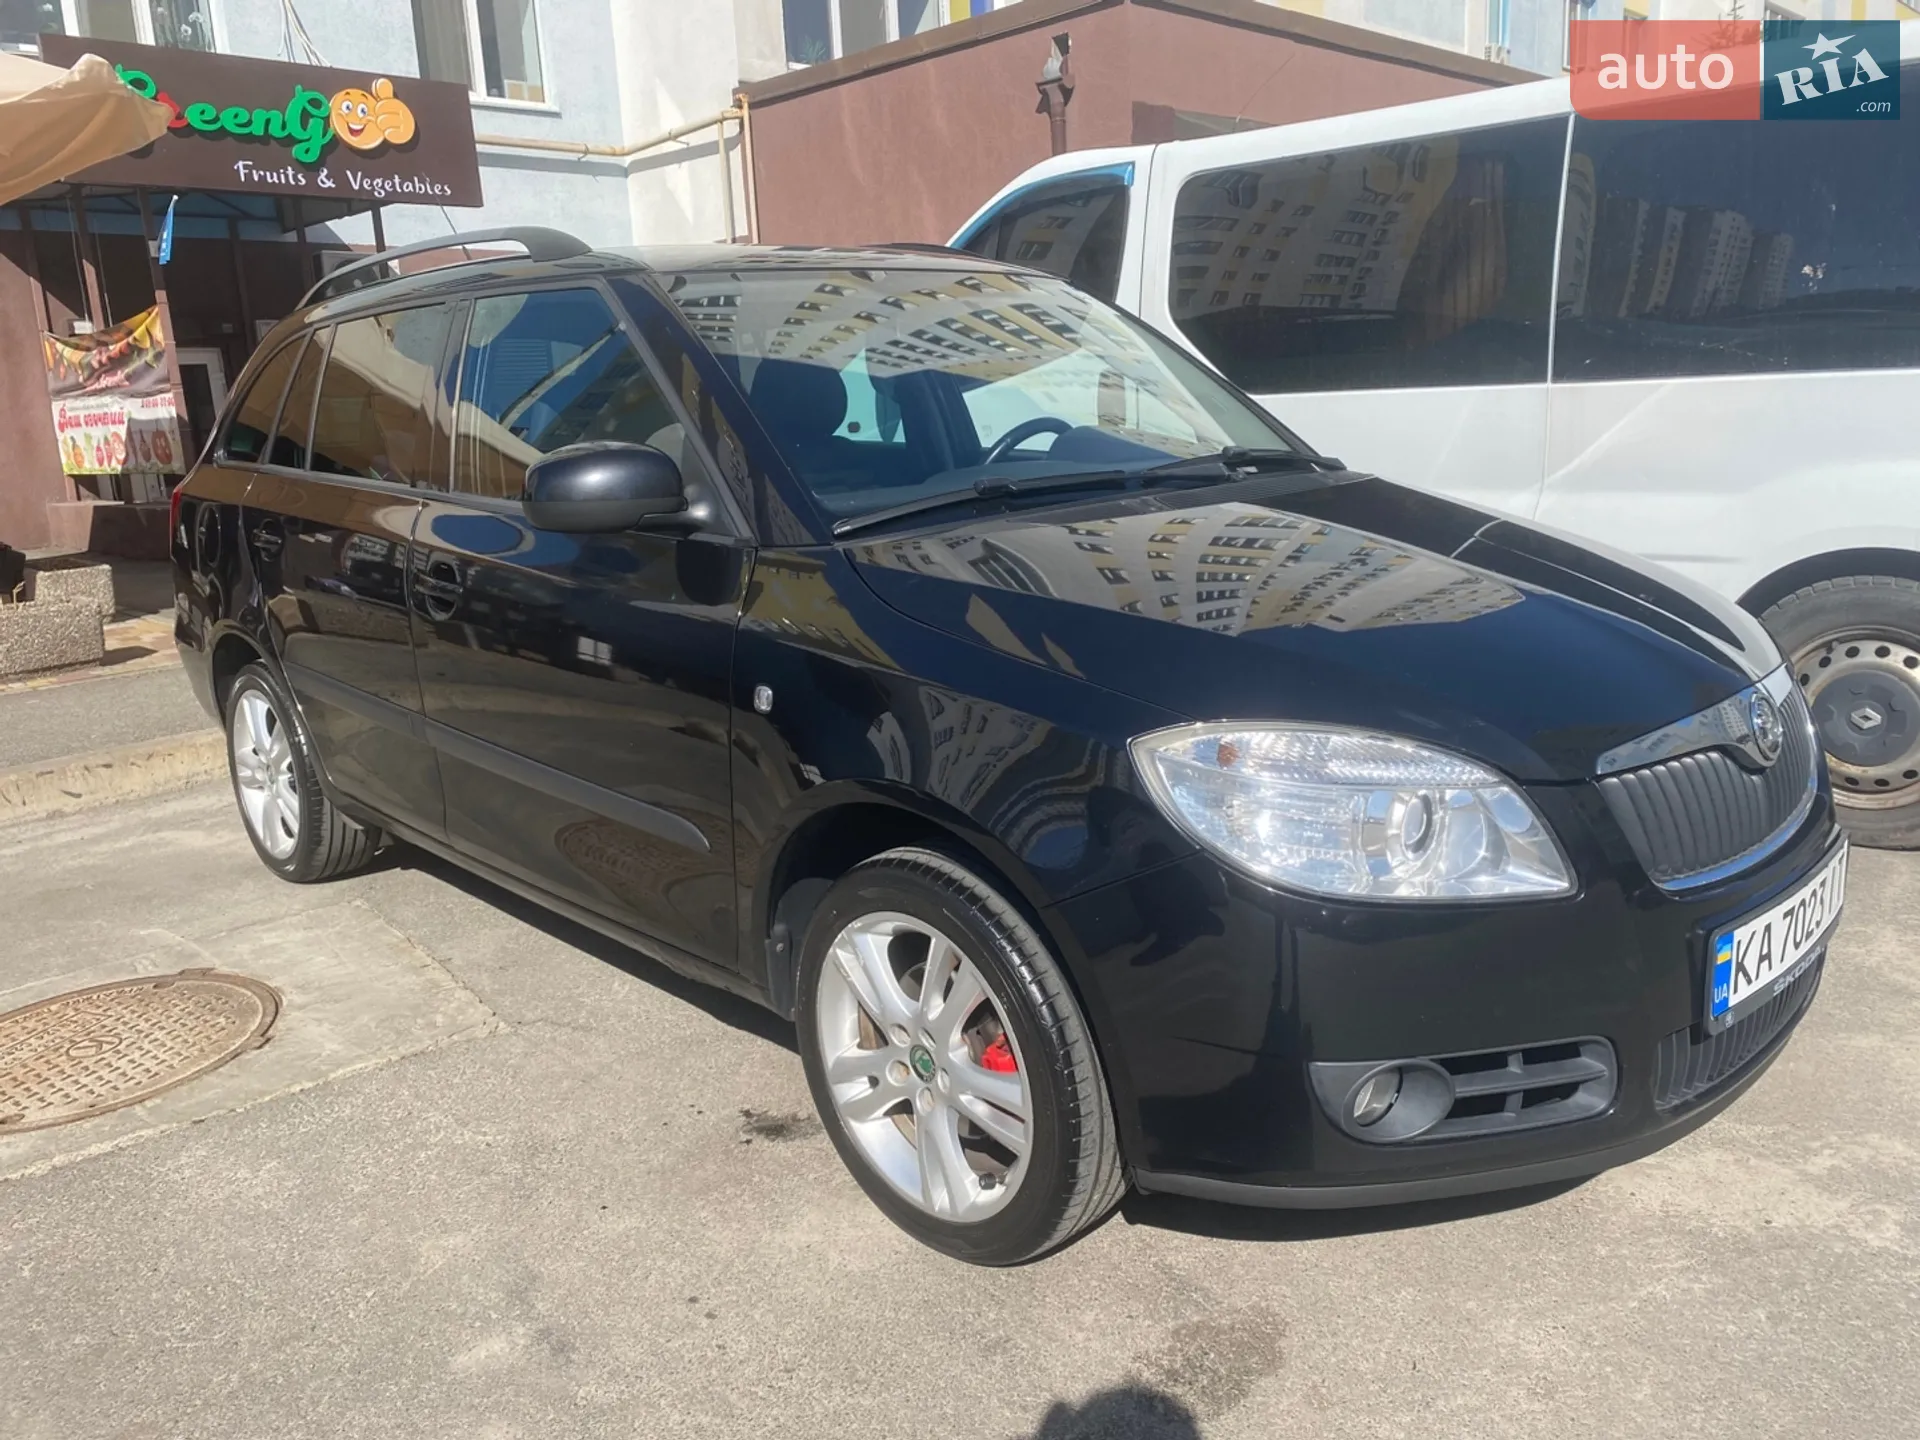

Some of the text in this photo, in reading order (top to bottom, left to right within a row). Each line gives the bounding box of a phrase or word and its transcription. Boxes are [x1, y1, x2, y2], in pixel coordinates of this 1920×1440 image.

[233, 160, 307, 186] Fruits
[317, 168, 336, 188] &
[1733, 922, 1772, 995] KA
[1780, 876, 1827, 964] 7023
[1714, 981, 1728, 1004] UA
